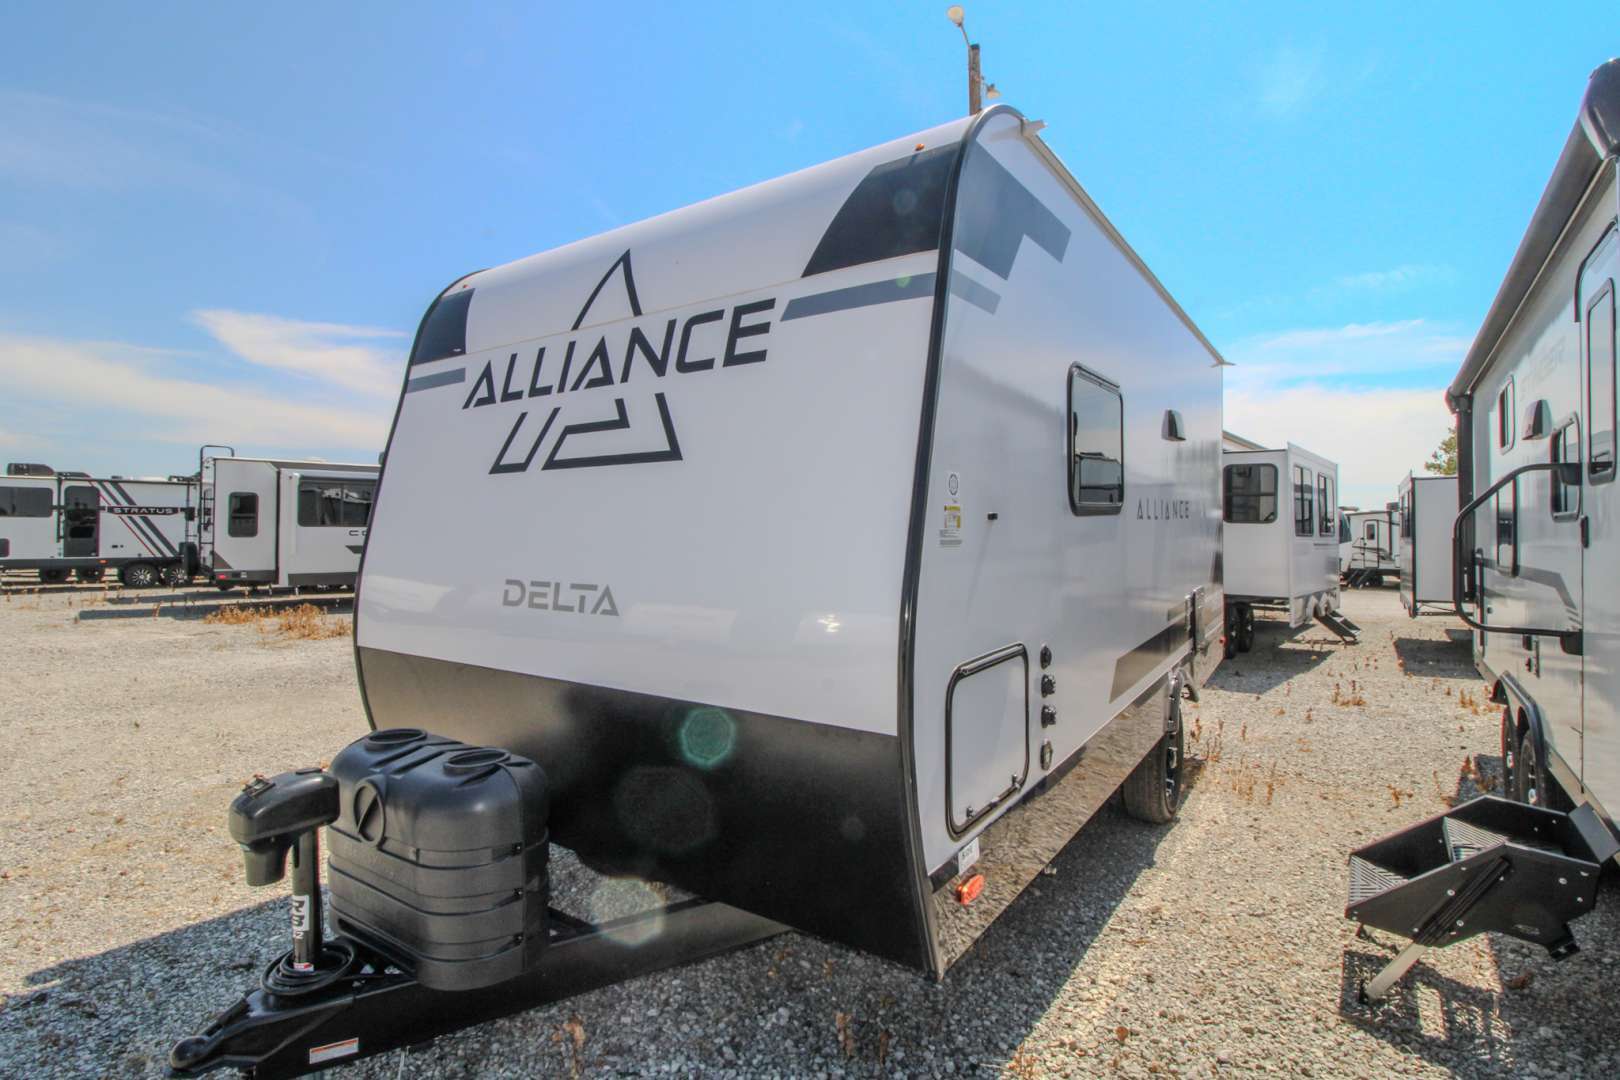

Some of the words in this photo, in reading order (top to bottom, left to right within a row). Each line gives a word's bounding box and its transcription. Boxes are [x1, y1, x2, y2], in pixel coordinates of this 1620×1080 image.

[462, 297, 777, 410] ALLIANCE
[113, 506, 174, 515] STRATUS
[1137, 498, 1190, 520] ALLIANCE
[502, 578, 620, 617] DELTA
